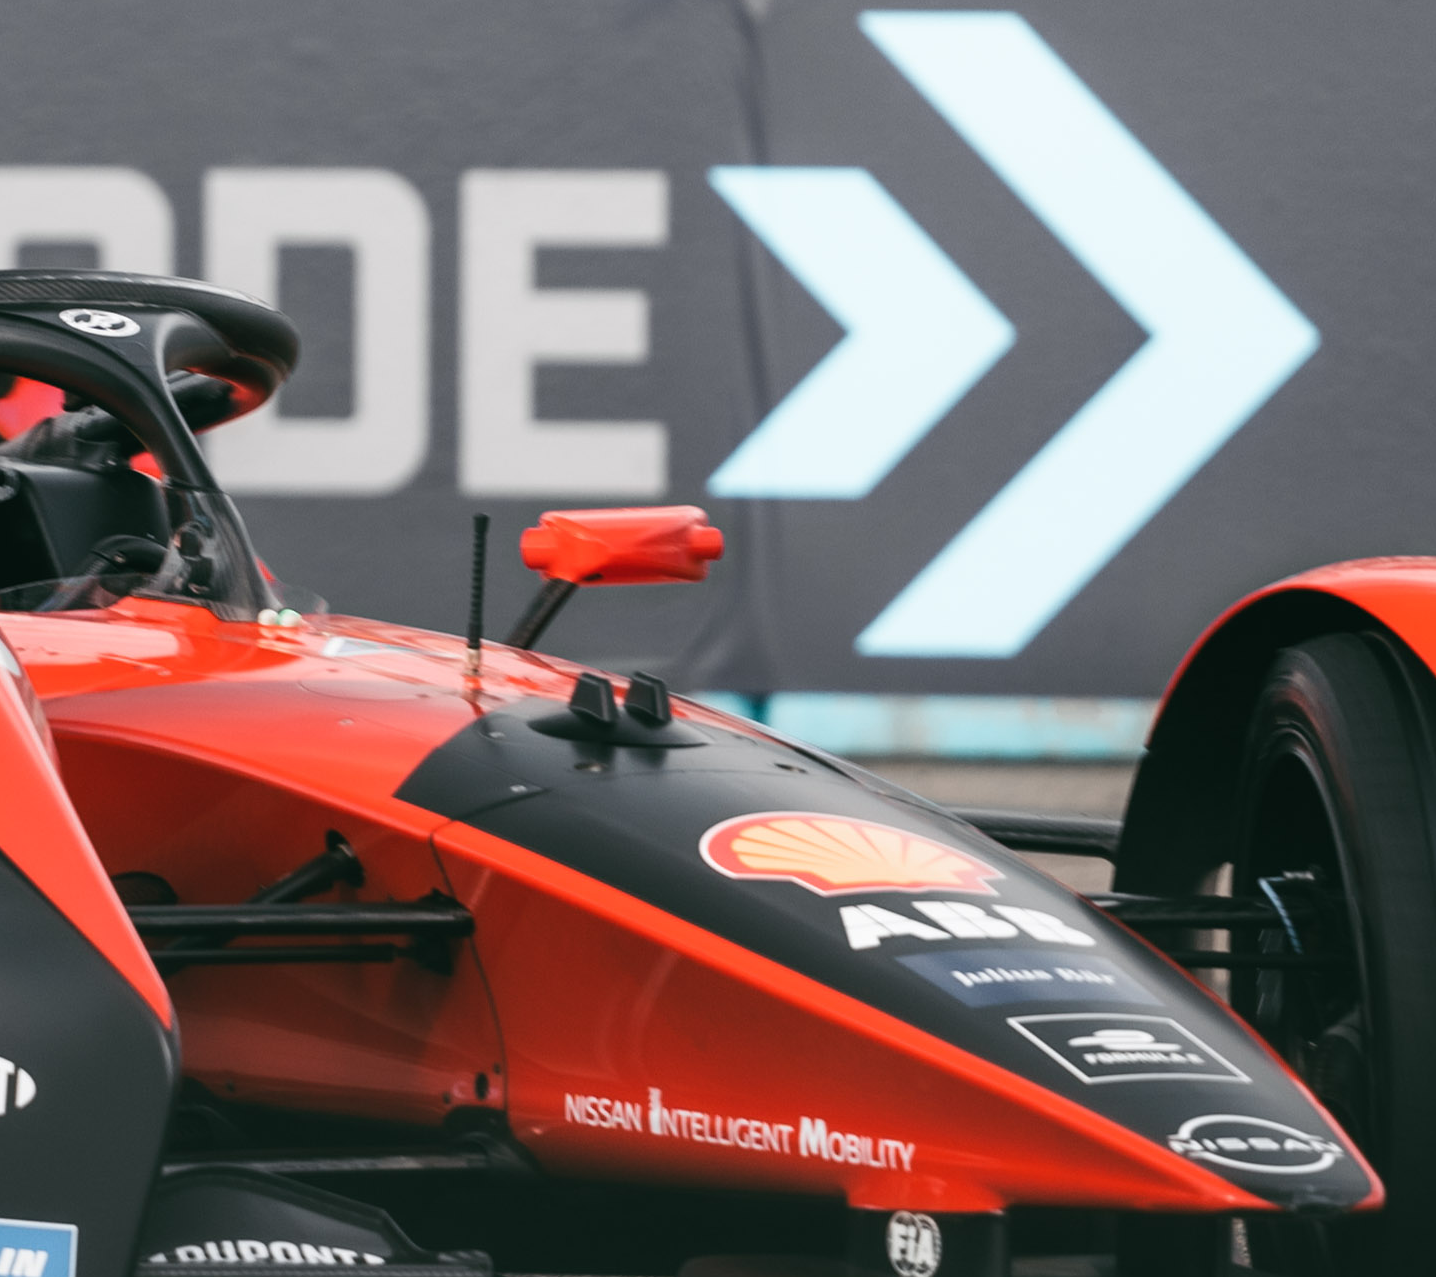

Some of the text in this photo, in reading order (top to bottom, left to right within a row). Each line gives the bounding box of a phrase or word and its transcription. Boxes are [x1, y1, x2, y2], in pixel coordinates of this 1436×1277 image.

[838, 893, 1098, 951] ABB
[564, 1091, 643, 1133] NISSAN
[1168, 1135, 1345, 1156] NISSAN
[174, 1239, 359, 1266] DUPONT
